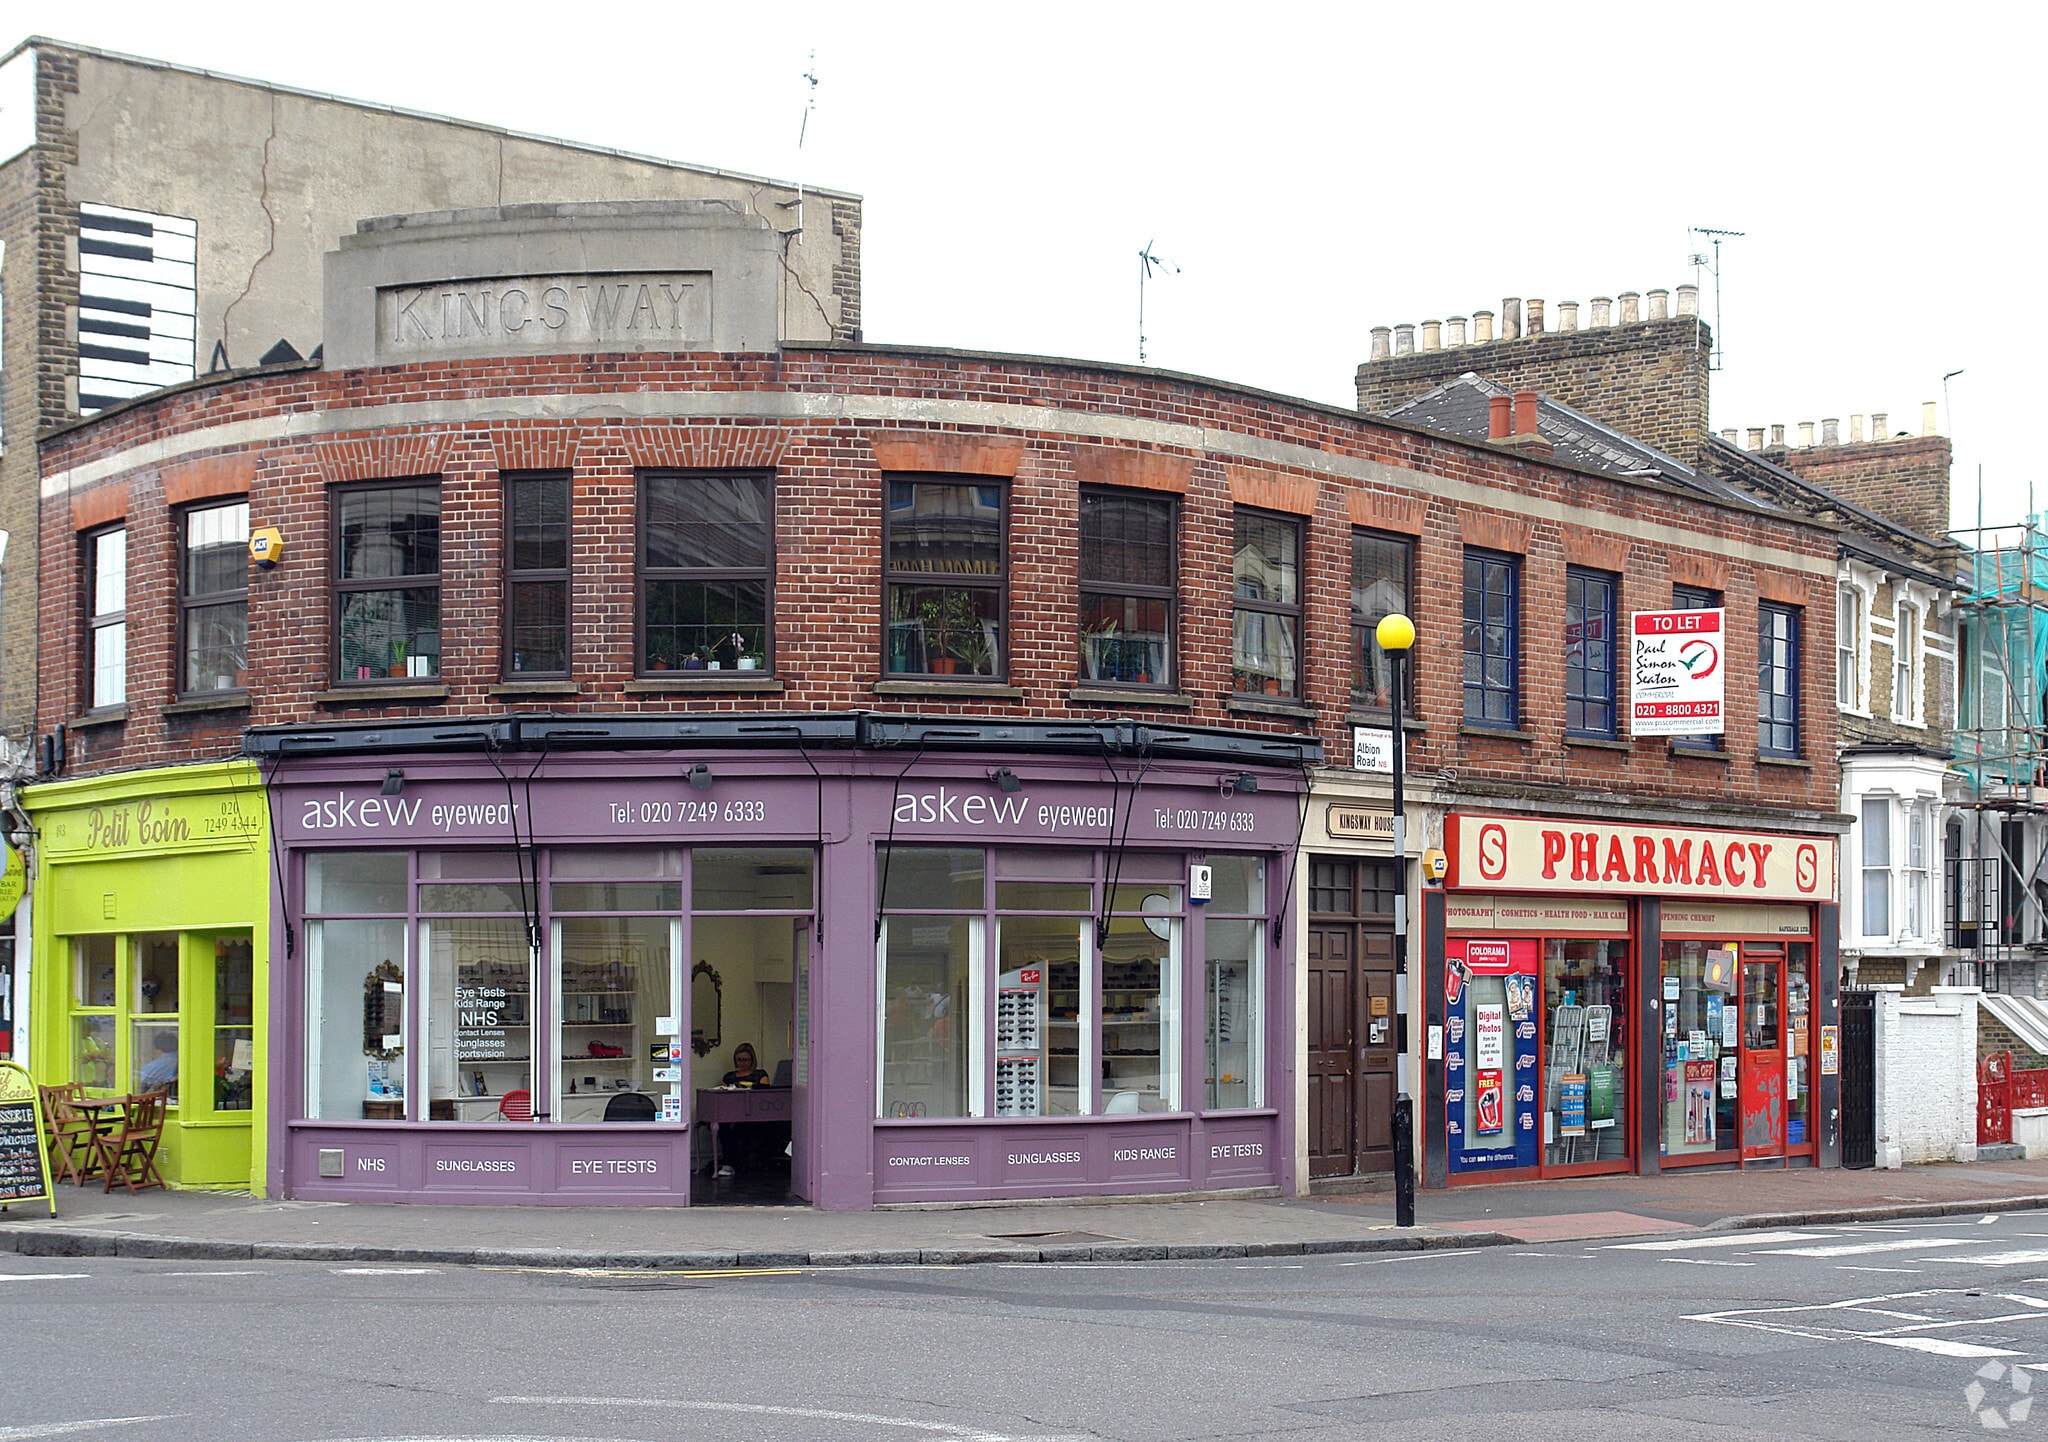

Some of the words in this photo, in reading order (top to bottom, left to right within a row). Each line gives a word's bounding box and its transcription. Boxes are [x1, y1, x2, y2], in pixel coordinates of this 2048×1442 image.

[394, 283, 694, 342] KINGSWAY
[1653, 617, 1673, 631] TO
[1677, 615, 1702, 630] LET
[1636, 639, 1666, 655] Paul
[1636, 655, 1676, 670] Simon
[1636, 670, 1676, 685] Seaton
[1636, 705, 1656, 716] 020
[1665, 704, 1691, 715] 8800
[1693, 703, 1718, 714] 4321
[1357, 742, 1381, 754] Albion
[1356, 755, 1376, 767] Road
[221, 801, 239, 816] 020
[301, 791, 423, 829] askew
[431, 803, 519, 832] eyewear
[609, 802, 635, 824] Tel:
[640, 803, 672, 823] 020
[677, 801, 718, 822] 7249
[723, 801, 765, 822] 6333
[893, 786, 1029, 825] askew
[87, 807, 131, 848] Petit
[137, 799, 191, 845] Coin
[204, 817, 228, 833] 7249
[1154, 808, 1174, 829] Tel:
[1176, 810, 1198, 830] 020
[1201, 811, 1227, 831] 7249
[1229, 812, 1255, 833] 6333
[1339, 813, 1372, 830] KINGSWAY
[1374, 816, 1394, 832] HOUSE
[1480, 824, 1506, 880] S
[1541, 830, 1772, 889] PHARMACY
[1796, 844, 1818, 893] S
[1501, 909, 1538, 918] COSMETICS
[1544, 910, 1570, 919] HEALTH
[1571, 911, 1588, 919] FOOD
[1593, 911, 1610, 919] HAIR
[1610, 912, 1626, 920] CARE
[1690, 914, 1715, 922] CHEMIST
[1470, 946, 1506, 956] COLORAMA
[454, 987, 475, 999] Eye
[478, 986, 506, 998] Tests
[454, 999, 474, 1008] Kids
[476, 999, 506, 1010] Range
[461, 1011, 498, 1026] NHS
[1478, 1010, 1502, 1023] Digital
[453, 1029, 479, 1037] Contact
[1478, 1024, 1502, 1033] Photos
[454, 1039, 506, 1049] Sunglasses
[453, 1050, 505, 1060] Sportsvision
[1700, 1064, 1713, 1077] OFF
[1478, 1079, 1495, 1088] FREE
[1007, 1150, 1081, 1165] SUNGLASSES
[1113, 1148, 1138, 1162] KIDS
[1140, 1147, 1176, 1160] RANGE
[1210, 1145, 1232, 1158] EYE
[1233, 1144, 1263, 1157] TESTS
[357, 1158, 386, 1172] NHS
[436, 1159, 516, 1173] SUNGLASSES
[571, 1160, 603, 1174] EYE
[607, 1159, 657, 1174] TESTS
[888, 1156, 932, 1166] CONTACT
[934, 1156, 970, 1166] LENSES
